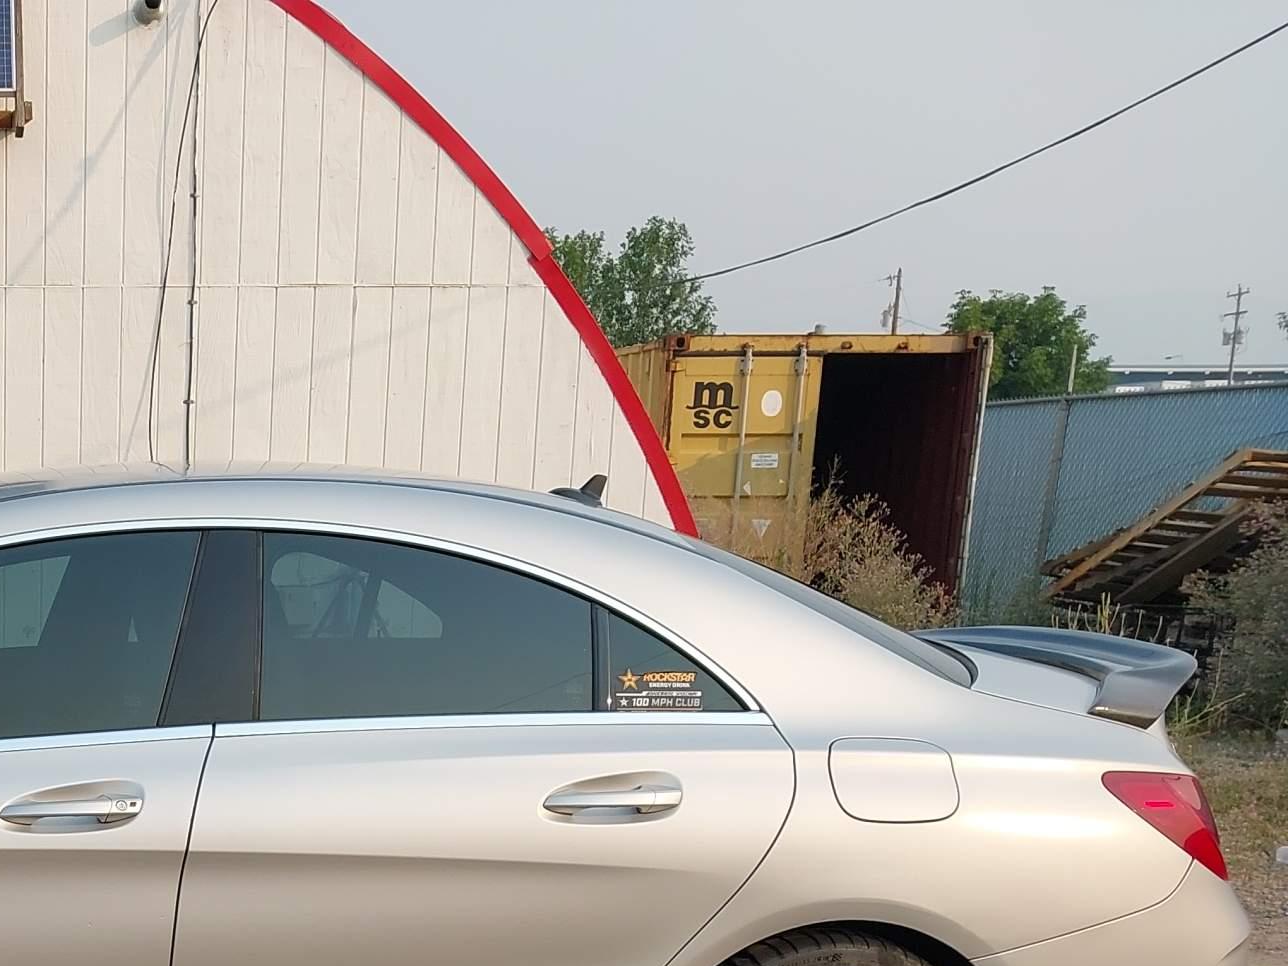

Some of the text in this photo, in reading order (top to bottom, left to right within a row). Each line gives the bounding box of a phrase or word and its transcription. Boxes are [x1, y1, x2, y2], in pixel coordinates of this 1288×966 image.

[642, 672, 697, 682] ROCKSTAR
[631, 697, 701, 707] 100 MPH CLUB
